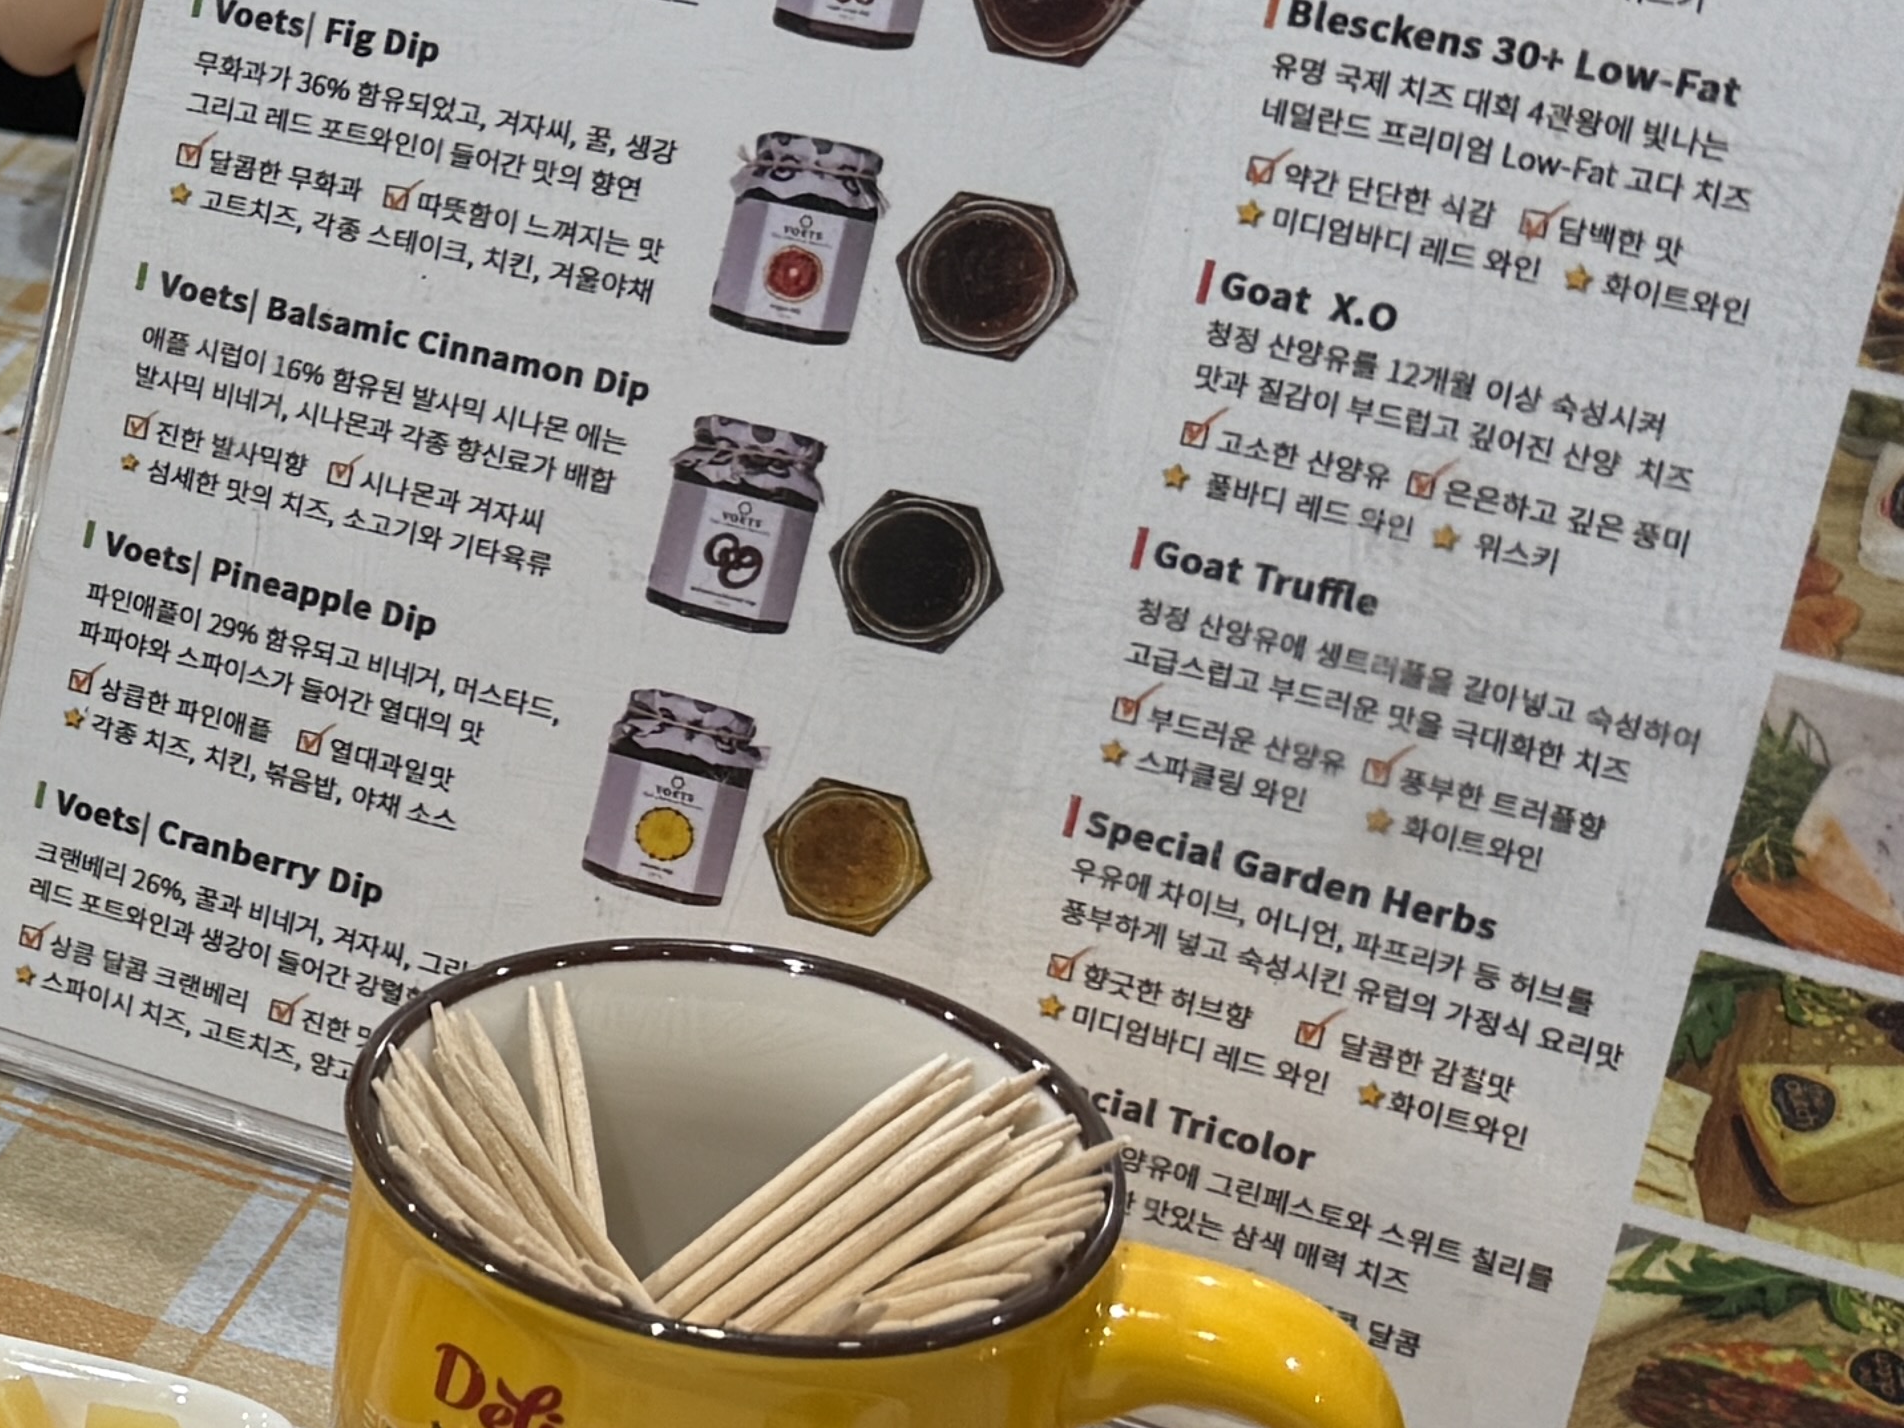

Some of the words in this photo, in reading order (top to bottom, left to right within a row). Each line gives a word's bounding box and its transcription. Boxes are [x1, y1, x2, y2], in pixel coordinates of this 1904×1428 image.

[323, 16, 377, 58] Fig
[382, 26, 440, 68] Dip
[1490, 34, 1565, 72] 30+
[1573, 47, 1742, 108] Low-Fat
[192, 49, 293, 92] 무화과가
[294, 69, 351, 102] 36%
[356, 79, 487, 133] 함유되었고,
[493, 108, 573, 147] 겨자씨,
[584, 123, 612, 154] 꿀,
[624, 133, 679, 166] 생강
[1219, 270, 1312, 316] Goat
[1327, 291, 1399, 333] X.O
[265, 294, 411, 350] Balsamic
[416, 329, 584, 389] Cinnamon
[592, 366, 650, 406] Dip
[209, 555, 372, 621] Pineapple
[379, 598, 437, 640] Dip
[1152, 539, 1244, 586] Goat
[1254, 560, 1379, 617] Truffle
[157, 819, 321, 891] Cranberry
[327, 865, 383, 907] Dip
[1083, 809, 1225, 871] Special
[1232, 848, 1372, 909] Garden
[1379, 884, 1498, 941] Herbs
[1083, 1086, 1159, 1129] cial
[1167, 1104, 1317, 1171] Tricolor
